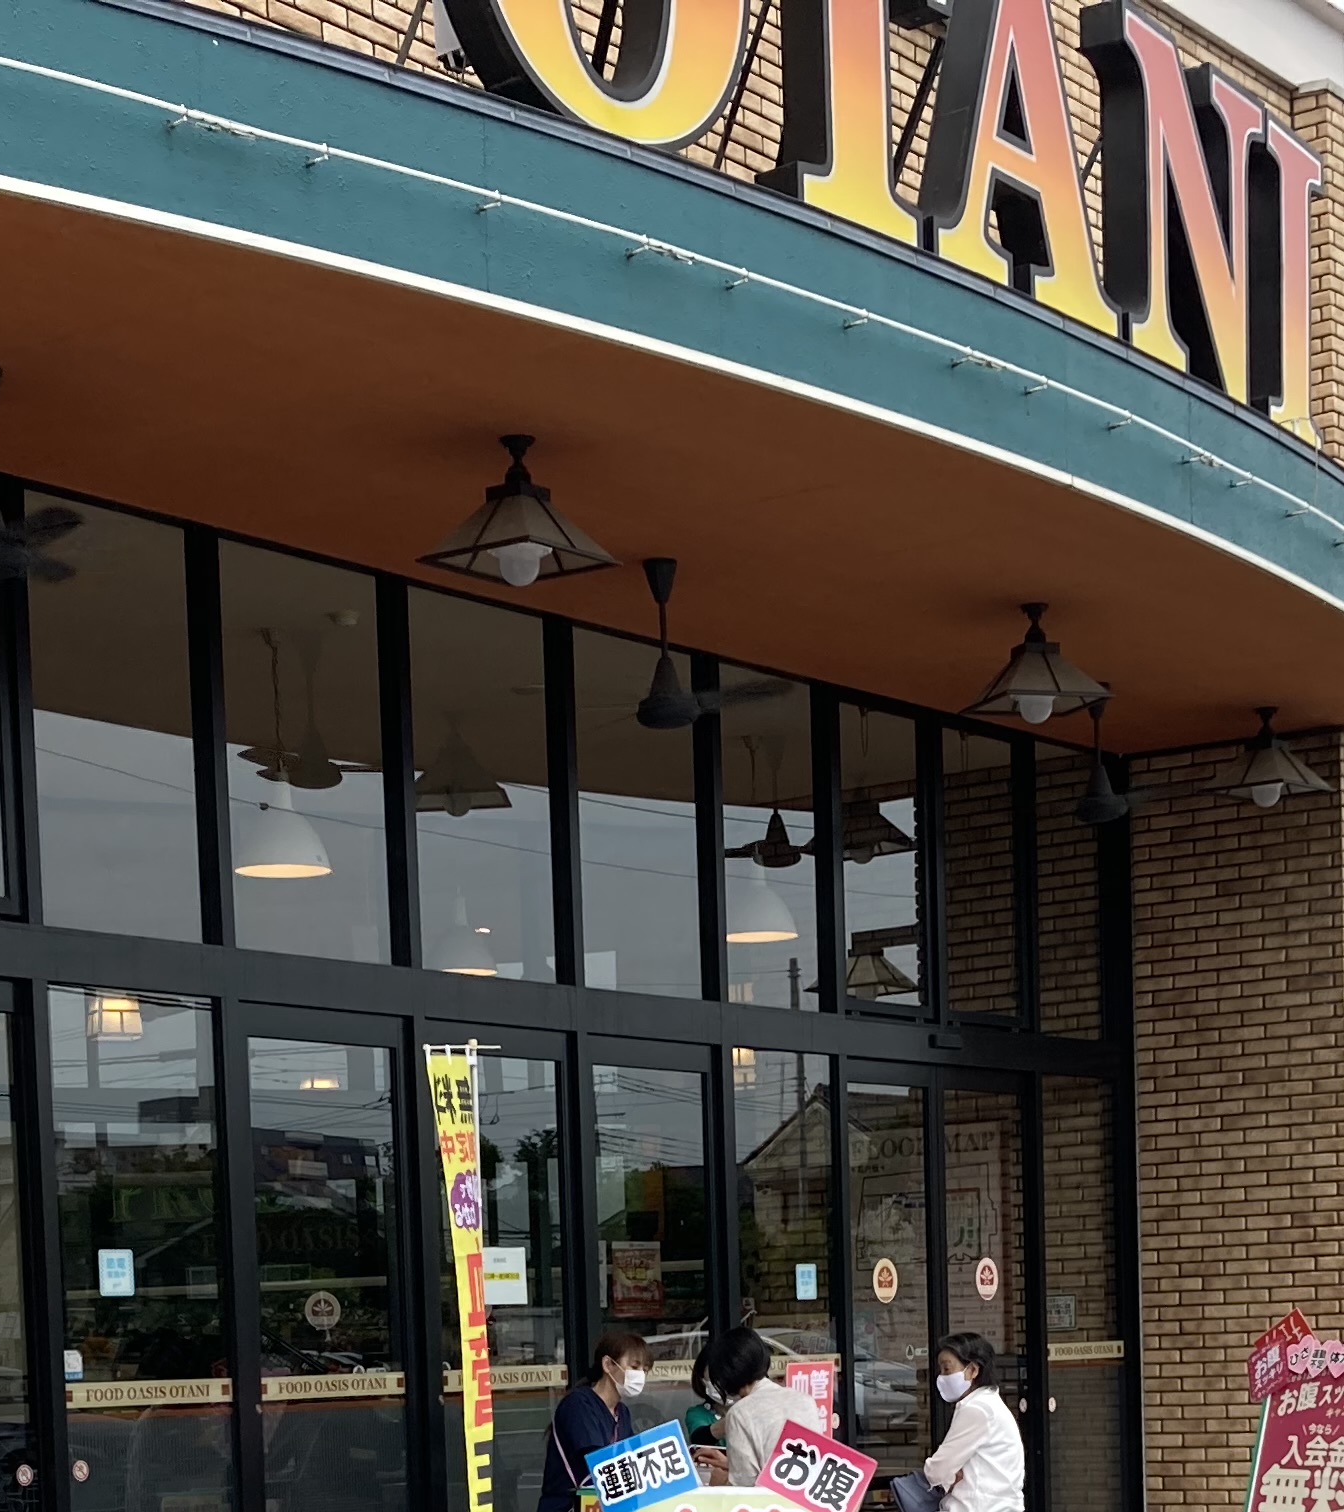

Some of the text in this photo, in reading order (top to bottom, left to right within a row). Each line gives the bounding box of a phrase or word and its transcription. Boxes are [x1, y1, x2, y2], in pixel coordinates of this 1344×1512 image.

[1054, 1346, 1074, 1357] FOOD
[277, 1376, 388, 1395] FOOD OASIS OTANI
[520, 1370, 553, 1383] OTANI
[791, 1369, 830, 1400] 血管
[85, 1384, 211, 1403] FOOD OASIS OTANI
[1308, 1422, 1333, 1435] 今なら
[597, 1439, 687, 1502] 運動不足
[774, 1441, 860, 1512] お腹
